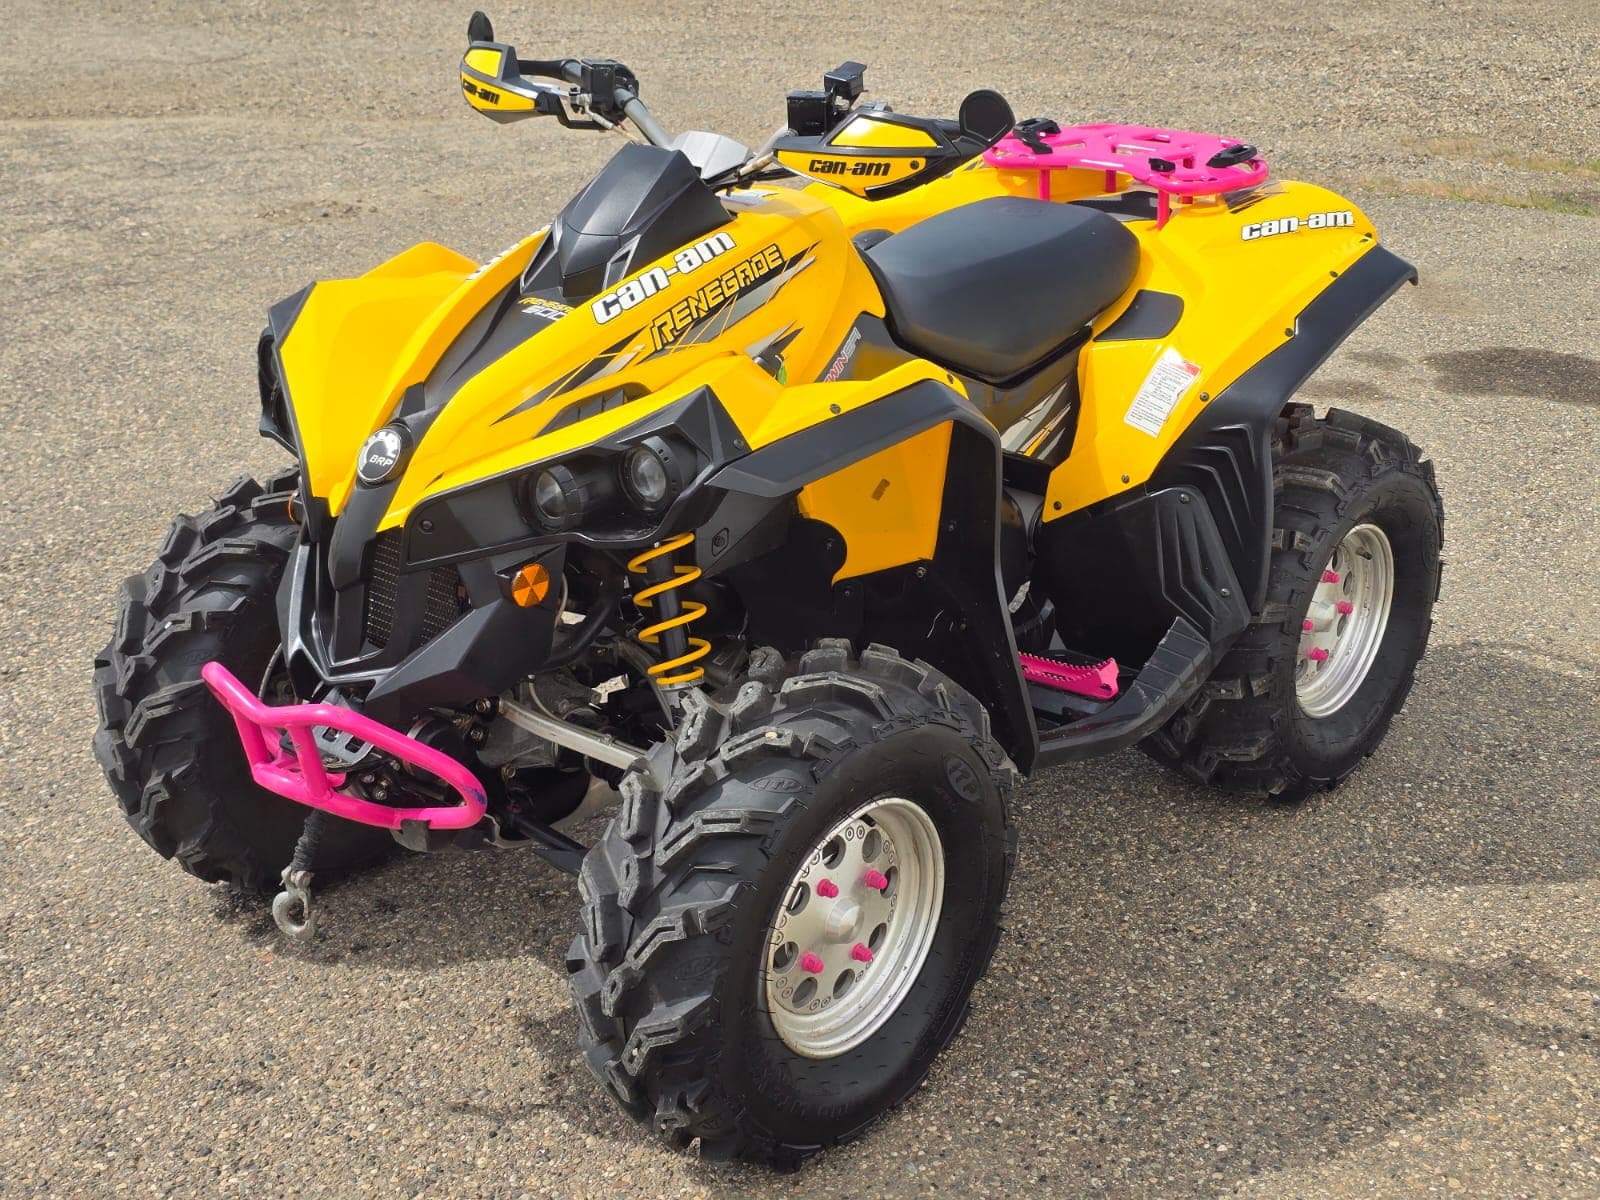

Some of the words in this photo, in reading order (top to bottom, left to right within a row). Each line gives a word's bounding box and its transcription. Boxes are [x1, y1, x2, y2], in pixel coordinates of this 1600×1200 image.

[808, 159, 891, 177] can-am
[1241, 211, 1355, 241] can-am
[591, 232, 737, 325] can-am
[650, 243, 787, 351] RENEGADE
[369, 454, 394, 467] BRP
